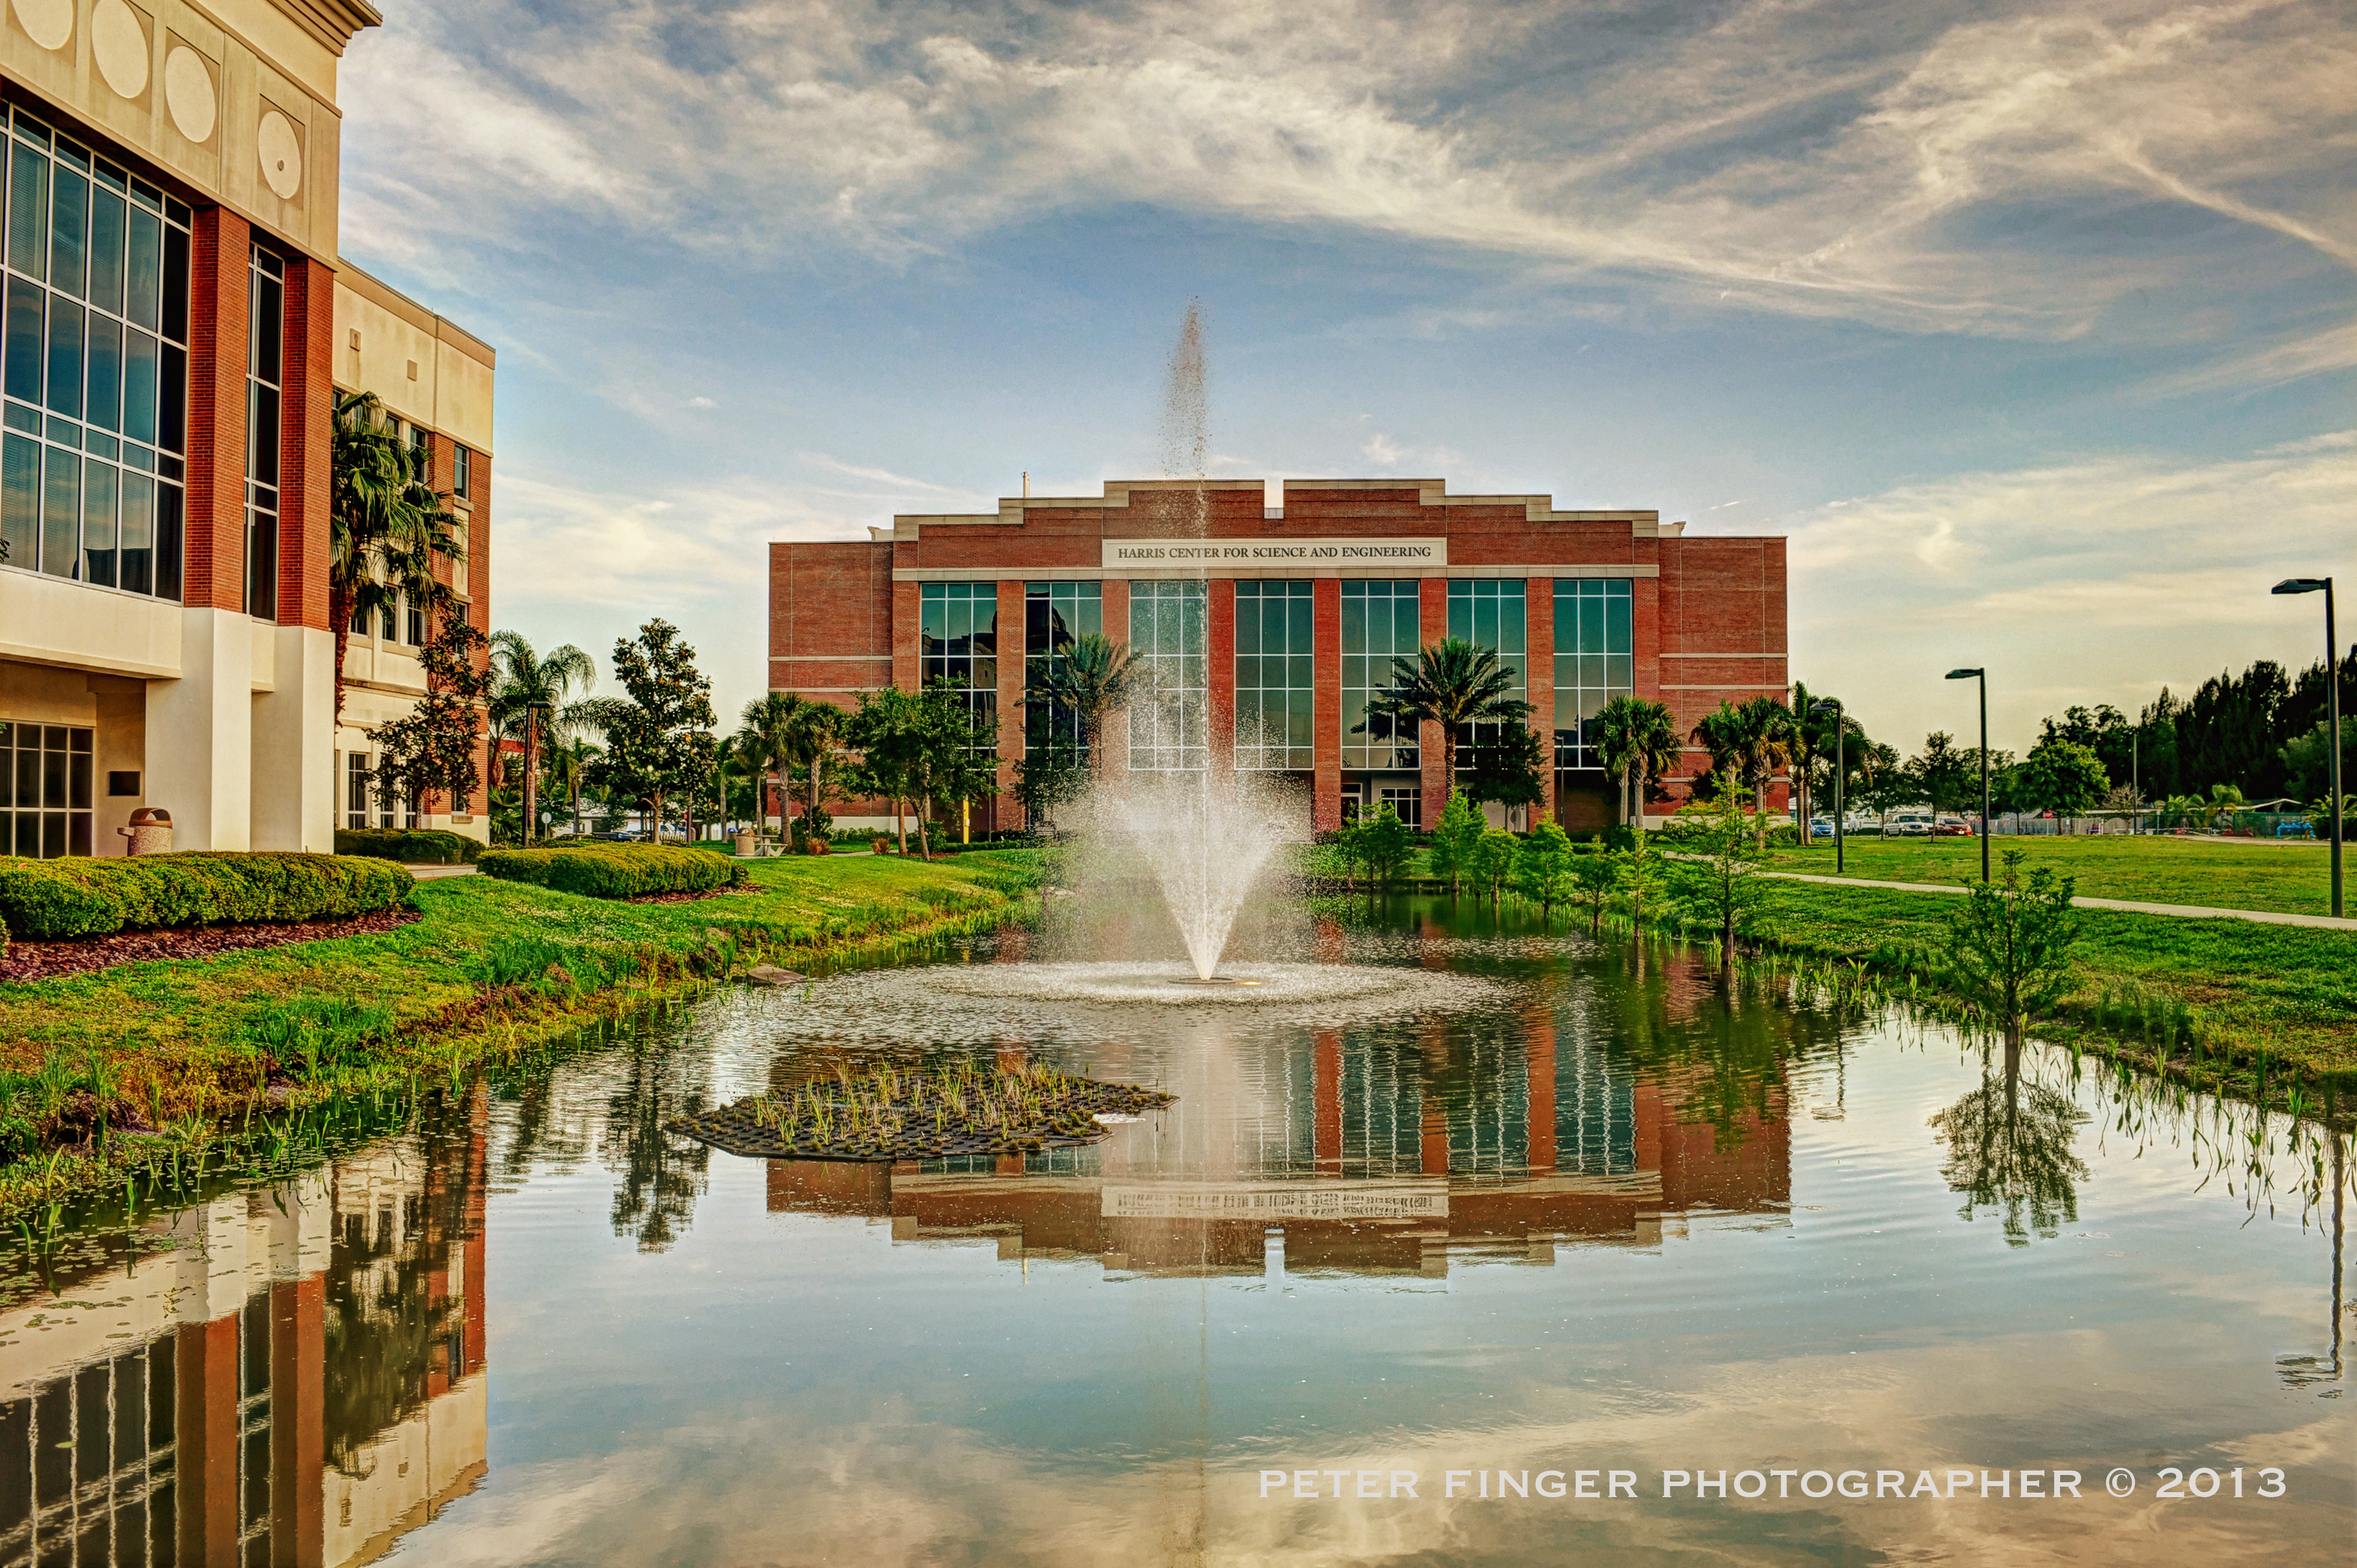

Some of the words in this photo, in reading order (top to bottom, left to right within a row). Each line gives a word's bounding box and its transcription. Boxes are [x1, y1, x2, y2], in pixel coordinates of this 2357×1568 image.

[1118, 548, 1165, 558] HARRIS
[1169, 548, 1220, 558] CENTER
[1223, 547, 1249, 558] FOR
[1253, 547, 1307, 558] SCIENCE
[1310, 547, 1338, 557] AND
[1342, 546, 1432, 557] ENGINEERING
